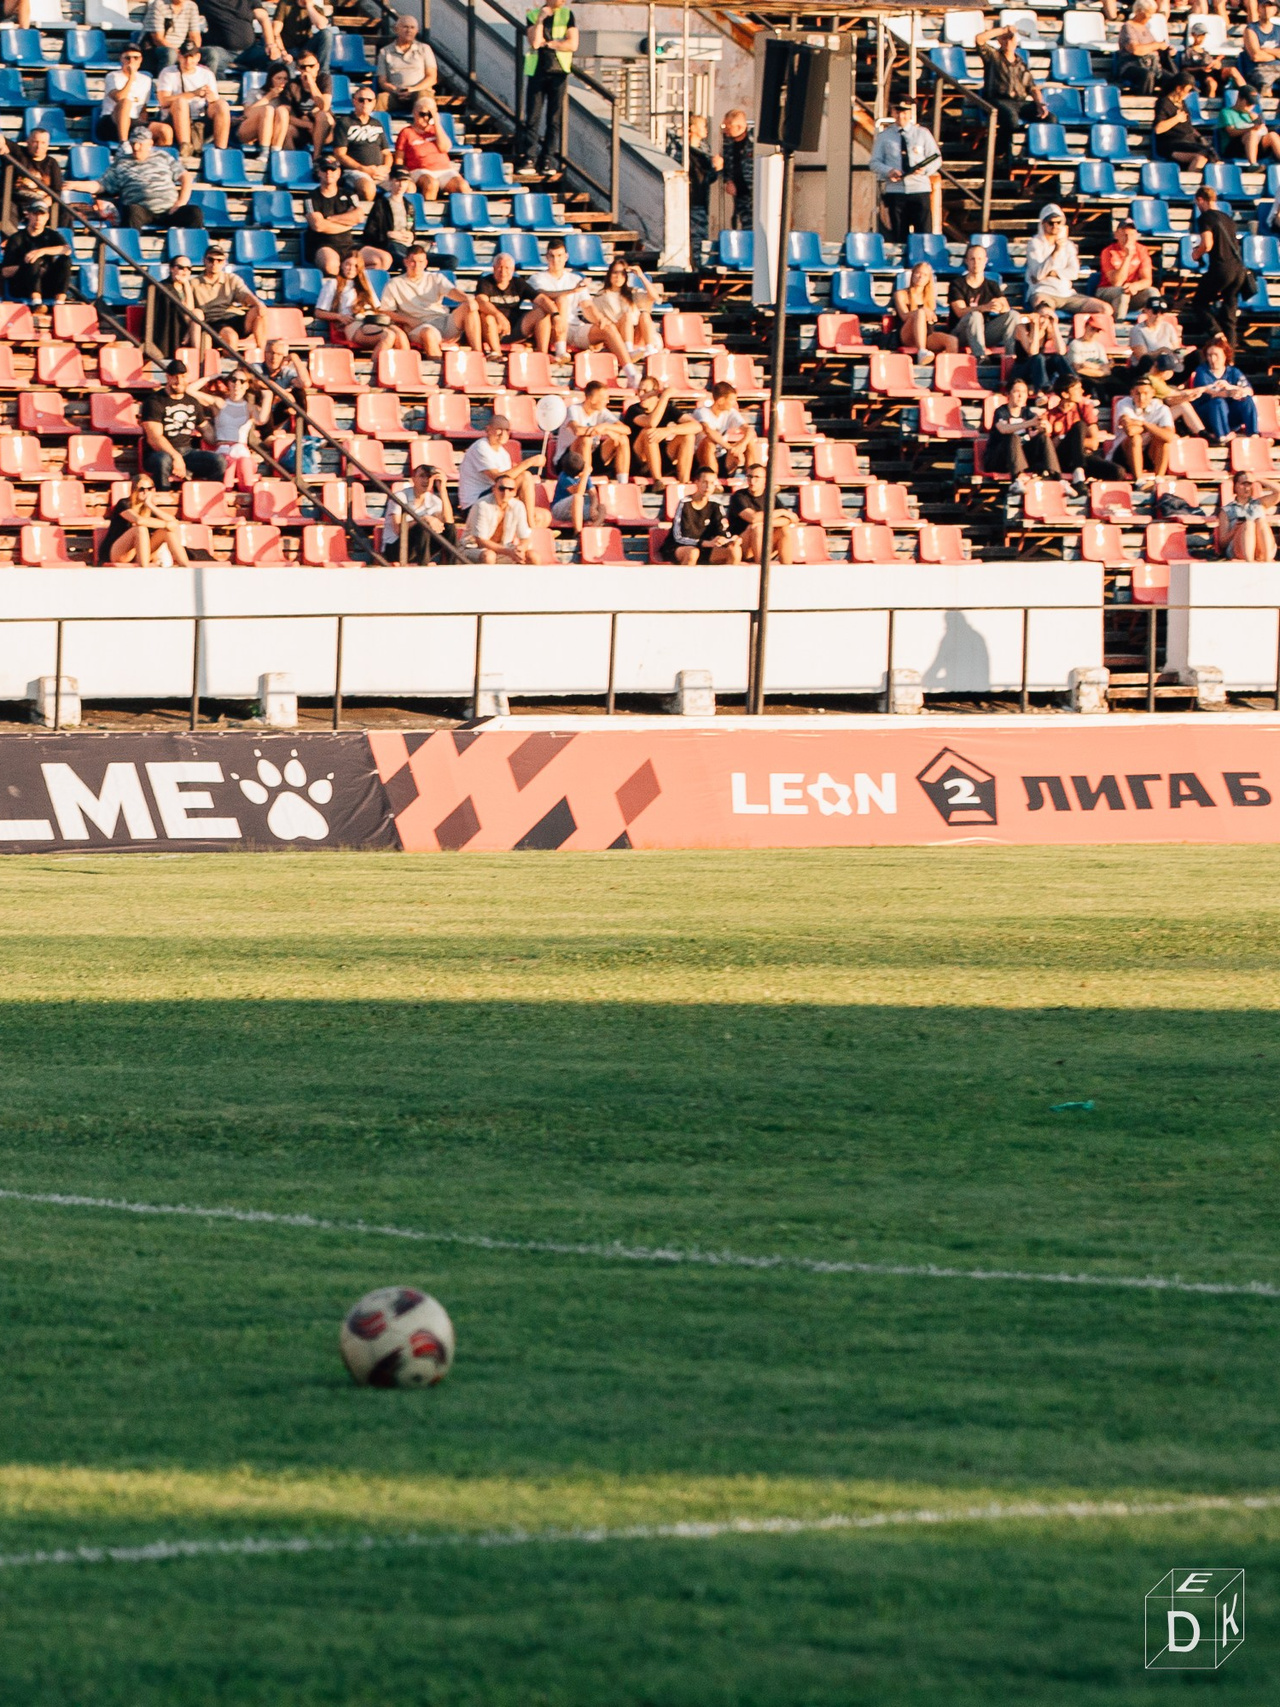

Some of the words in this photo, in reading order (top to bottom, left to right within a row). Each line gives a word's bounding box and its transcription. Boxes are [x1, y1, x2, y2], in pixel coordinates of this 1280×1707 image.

[943, 777, 982, 805] 2
[1021, 772, 1217, 811] ЛИГА
[1222, 771, 1272, 808] Б
